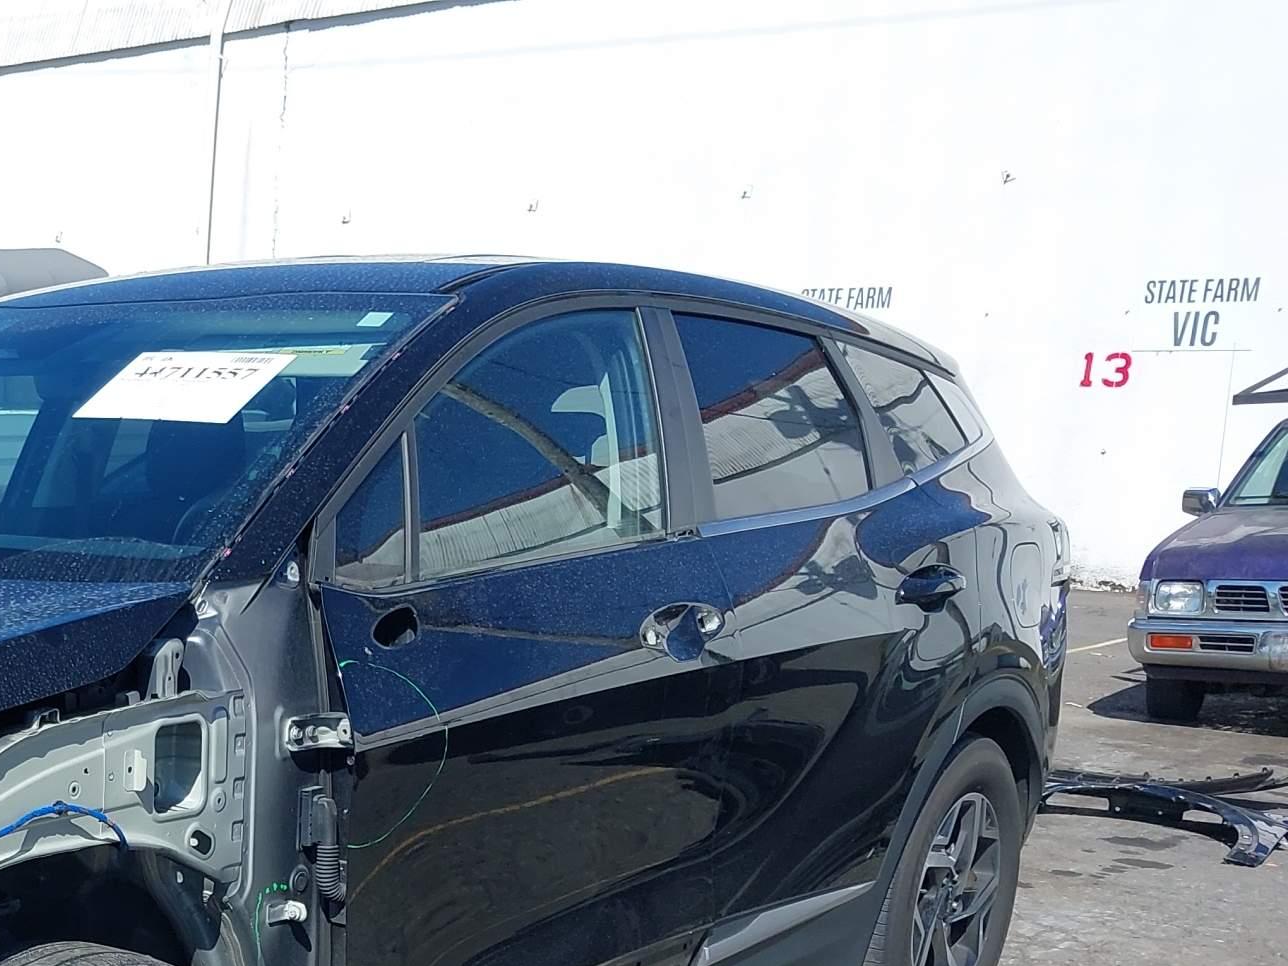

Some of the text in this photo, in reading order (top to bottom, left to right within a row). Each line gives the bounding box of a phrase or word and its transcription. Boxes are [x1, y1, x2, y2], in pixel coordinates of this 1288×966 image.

[846, 286, 893, 310] FARM
[1144, 277, 1261, 304] STATE FARM
[1173, 310, 1220, 347] VIC
[135, 366, 261, 380] 44711557
[1080, 352, 1132, 388] 13
